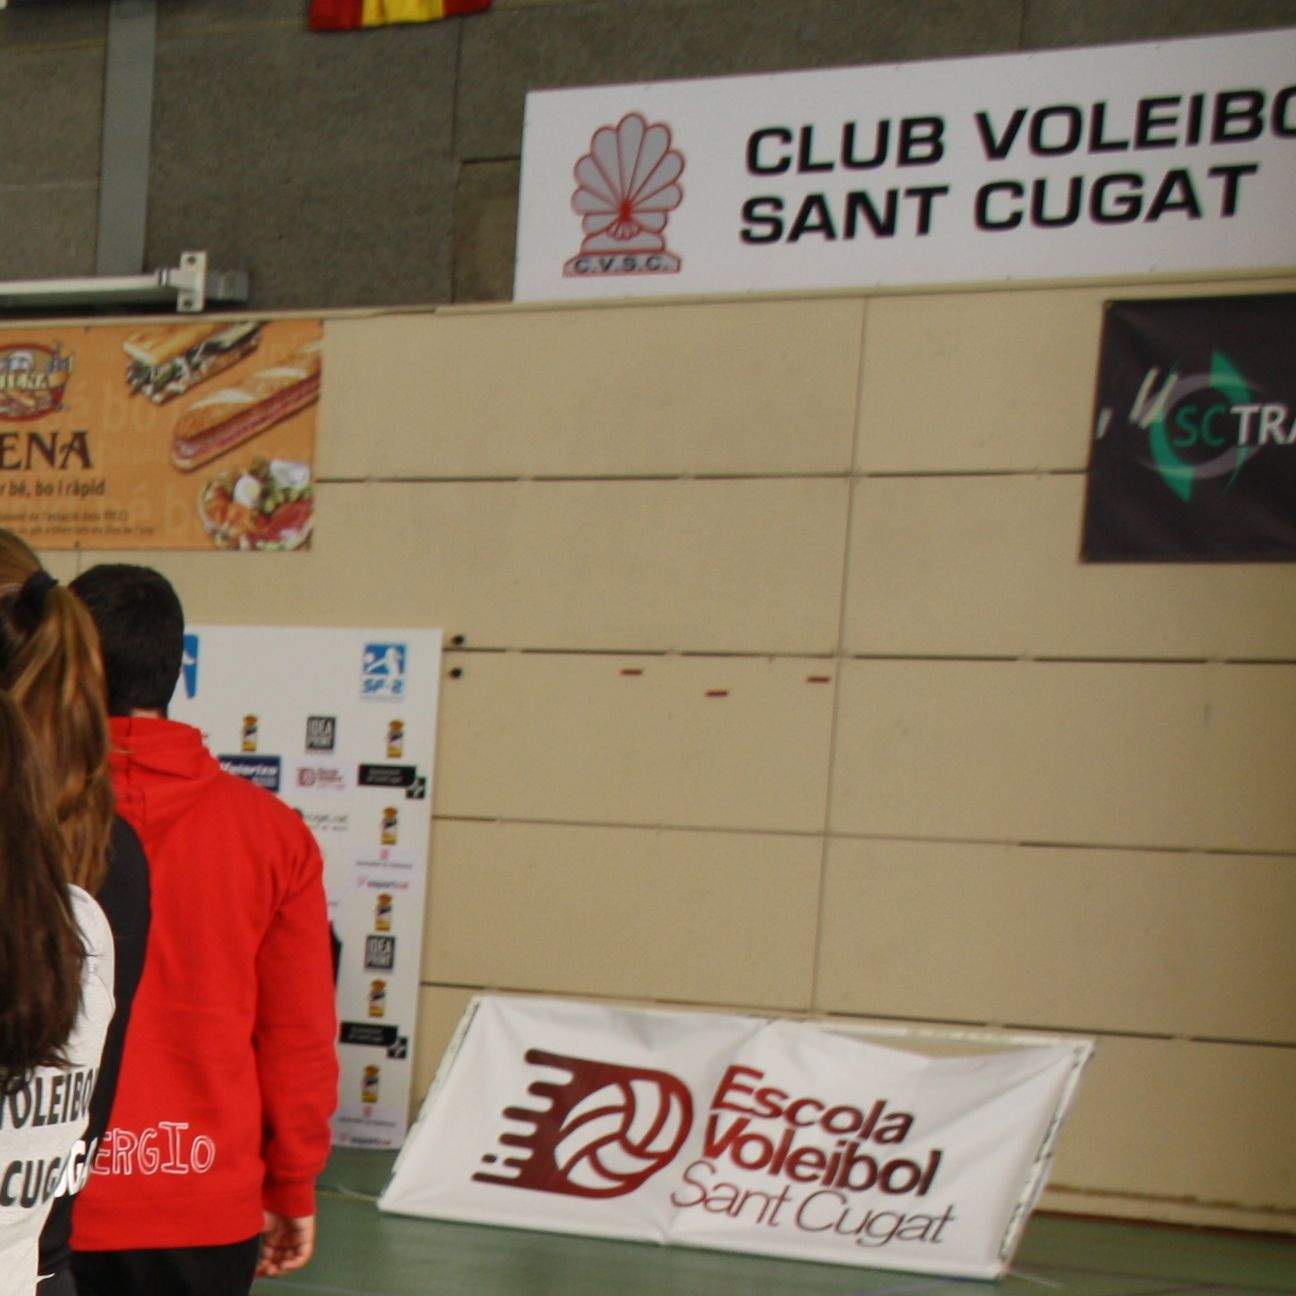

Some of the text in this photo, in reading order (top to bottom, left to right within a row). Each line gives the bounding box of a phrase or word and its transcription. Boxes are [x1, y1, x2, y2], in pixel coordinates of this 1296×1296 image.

[745, 114, 945, 178] CLUB
[739, 161, 1261, 246] SANT CUGAT
[34, 479, 56, 497] bo
[709, 1064, 915, 1146] Escola
[91, 1121, 217, 1176] ERGIO
[702, 1113, 943, 1198] Voleibol
[670, 1160, 956, 1248] Sant Cugat
